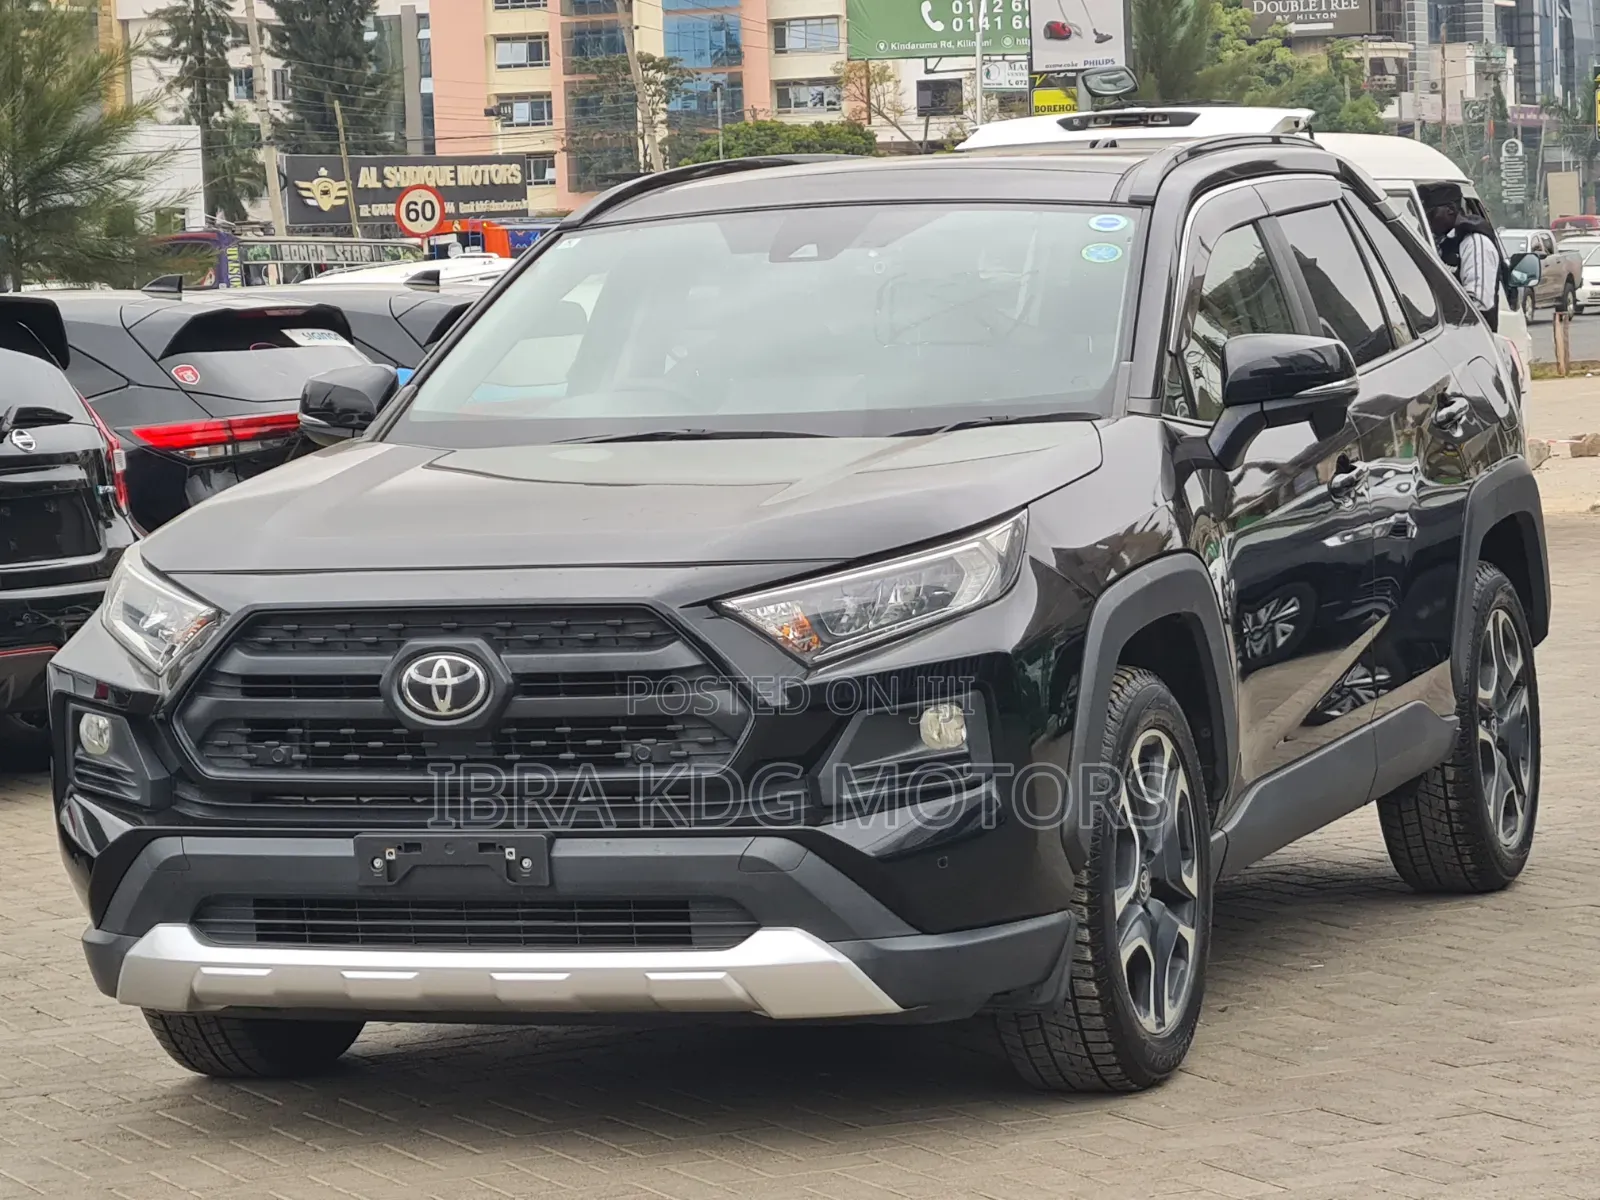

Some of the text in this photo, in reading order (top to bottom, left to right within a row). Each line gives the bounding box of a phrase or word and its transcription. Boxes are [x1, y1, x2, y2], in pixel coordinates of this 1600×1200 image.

[1253, 0, 1360, 14] DOUBLETREE
[952, 15, 1002, 32] 0141
[1296, 12, 1337, 20] HILTON
[890, 40, 938, 51] Kindaruma
[940, 40, 955, 49] Rd,
[1083, 57, 1116, 67] PHILIPS
[357, 166, 382, 188] AL
[457, 163, 523, 186] MOTORS
[404, 199, 436, 223] 60
[334, 243, 372, 262] STAR
